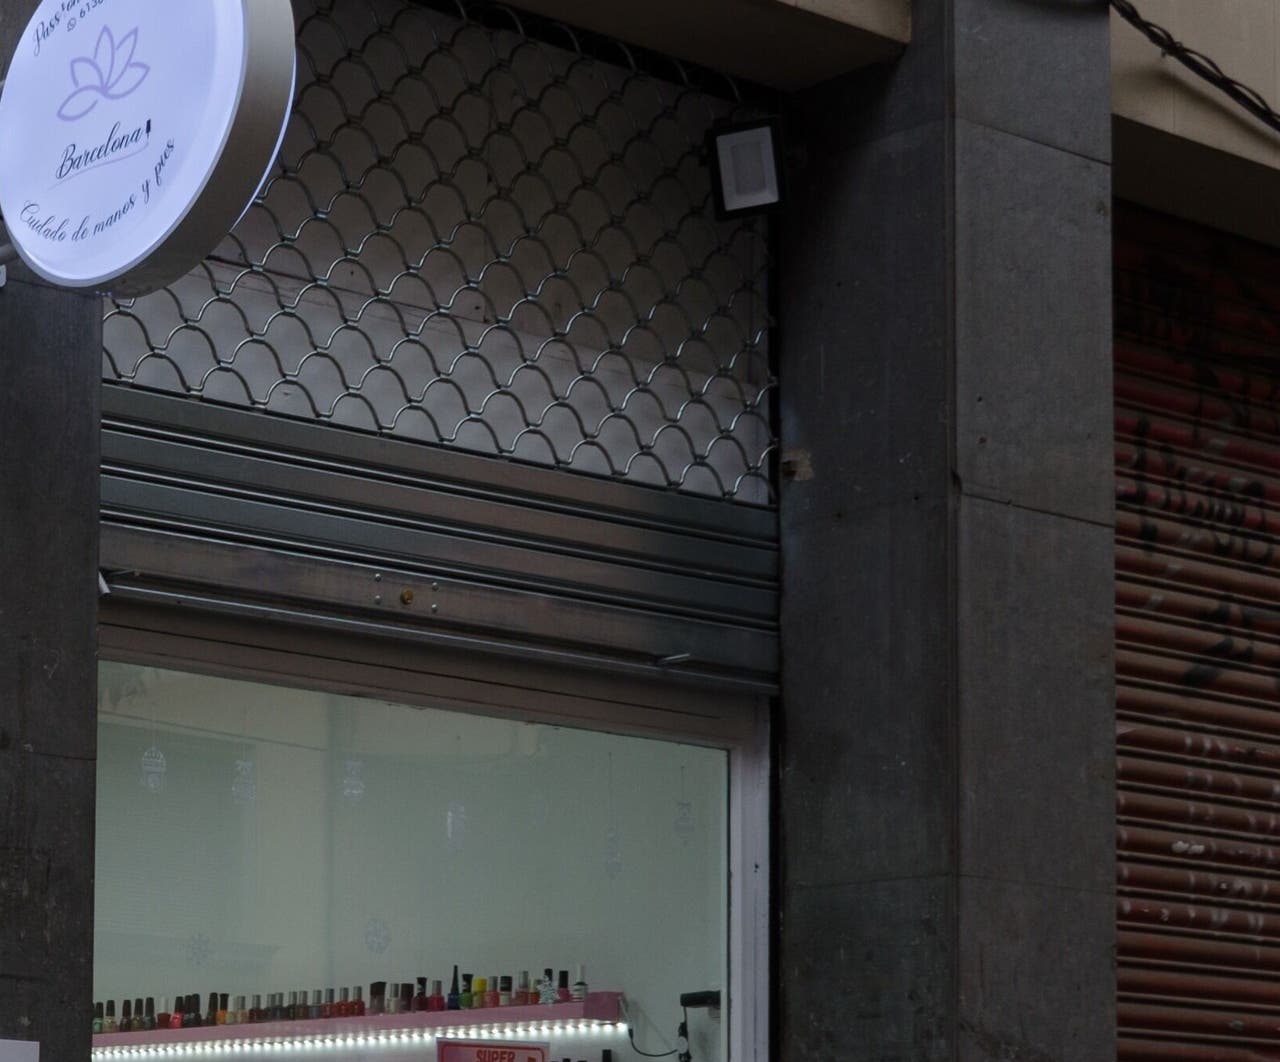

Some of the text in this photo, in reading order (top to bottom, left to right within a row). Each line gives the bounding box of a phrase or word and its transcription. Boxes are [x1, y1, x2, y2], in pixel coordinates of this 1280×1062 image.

[19, 139, 175, 242] Cuidado de manos y pies
[54, 121, 141, 180] Barcelona
